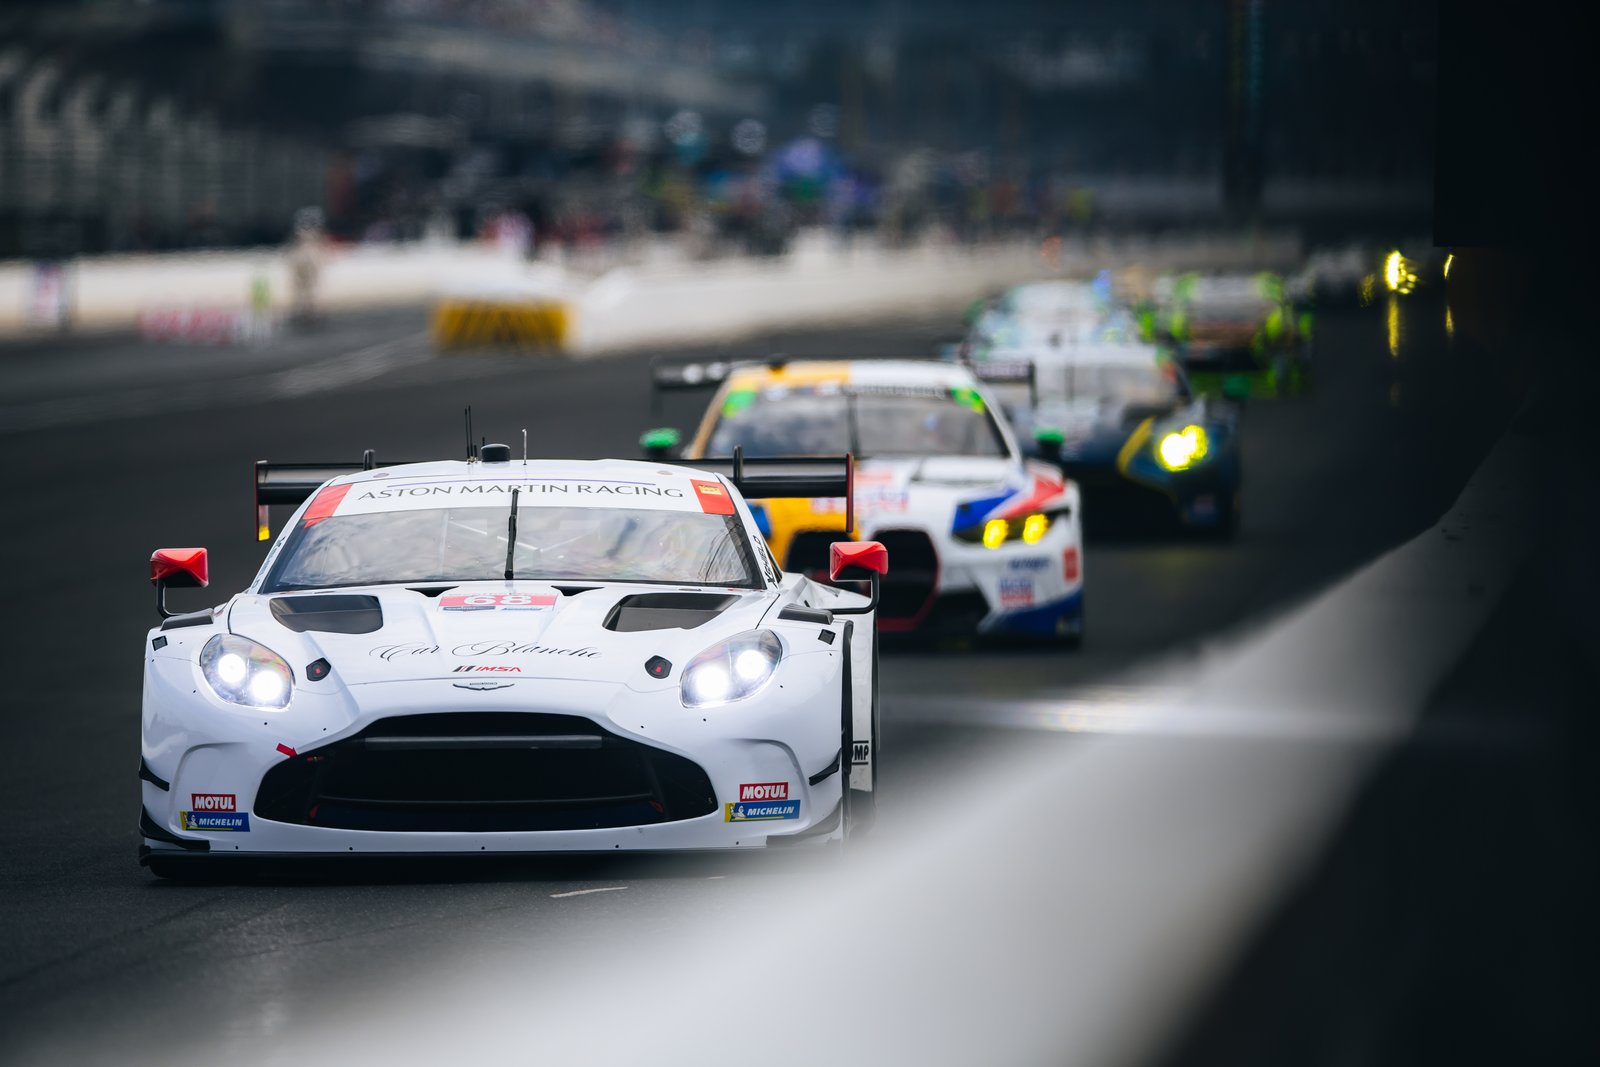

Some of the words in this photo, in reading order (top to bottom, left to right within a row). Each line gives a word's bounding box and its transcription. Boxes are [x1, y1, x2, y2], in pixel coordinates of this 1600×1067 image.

[358, 486, 452, 500] ASTON
[460, 484, 568, 494] MARTIN
[577, 485, 684, 498] RACING
[463, 595, 532, 605] 68
[452, 640, 602, 659] Blanche
[851, 744, 869, 761] MP
[741, 784, 787, 800] MOTUL
[194, 796, 234, 810] MOTUL
[747, 806, 795, 816] MICHELIN
[198, 818, 243, 827] MICHELIN
